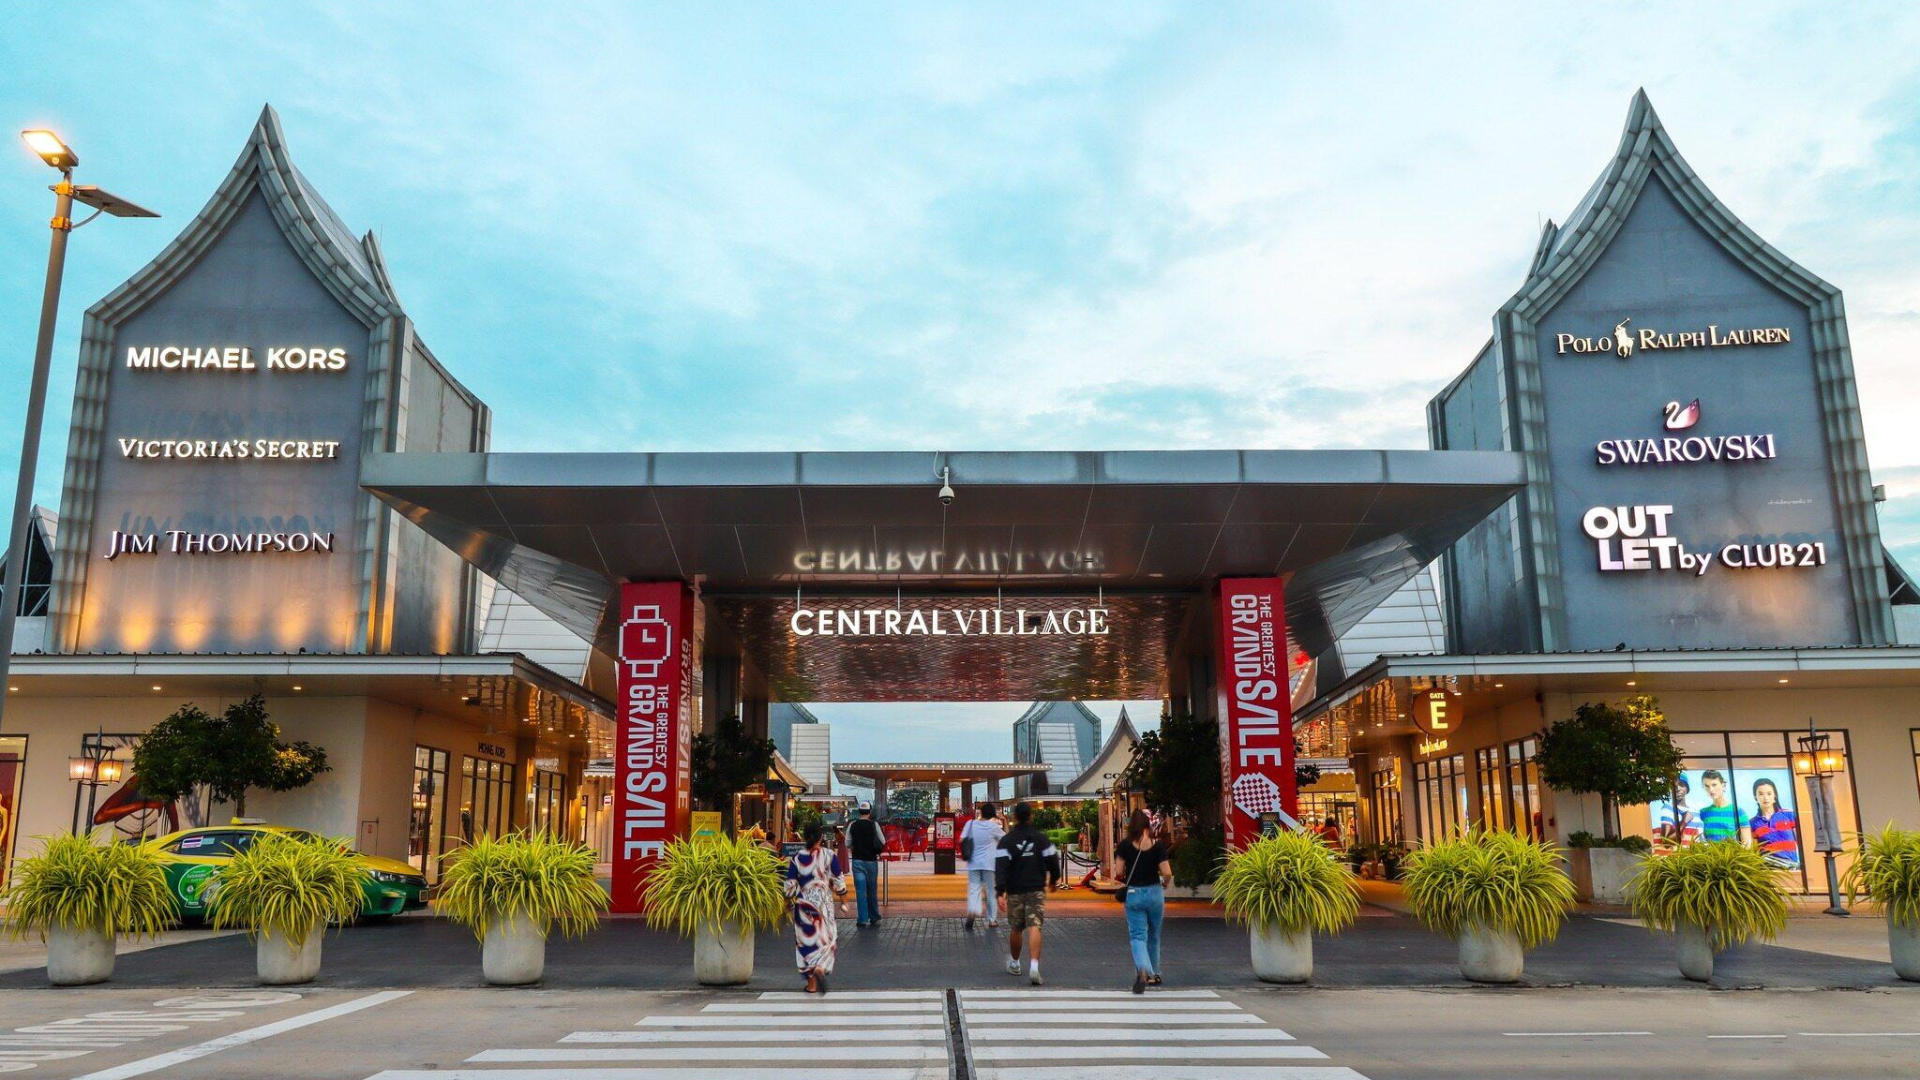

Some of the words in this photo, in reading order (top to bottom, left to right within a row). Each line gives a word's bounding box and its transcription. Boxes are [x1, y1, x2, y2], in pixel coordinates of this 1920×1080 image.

[1557, 333, 1612, 354] POLO
[1638, 329, 1705, 349] RALPH
[1708, 325, 1791, 346] LAUREN
[126, 347, 255, 369] MICHAEL
[267, 348, 346, 369] KORS
[119, 438, 249, 458] VICTORIA'S
[254, 439, 340, 458] SECRET
[1597, 434, 1776, 464] SWAROVSKI
[1583, 505, 1673, 539] OUT
[104, 531, 154, 558] JIM
[166, 531, 331, 552] THOMPSON
[1598, 537, 1678, 570] LET
[1678, 544, 1712, 575] by
[1721, 542, 1826, 568] CLUB21
[1259, 594, 1272, 618] THE
[791, 609, 947, 636] CENTRAL
[952, 609, 1109, 635] VILLAGE
[1261, 621, 1276, 677] GREATEST
[656, 684, 669, 709] THE
[1430, 701, 1448, 729] E
[655, 712, 668, 769] GREATEST
